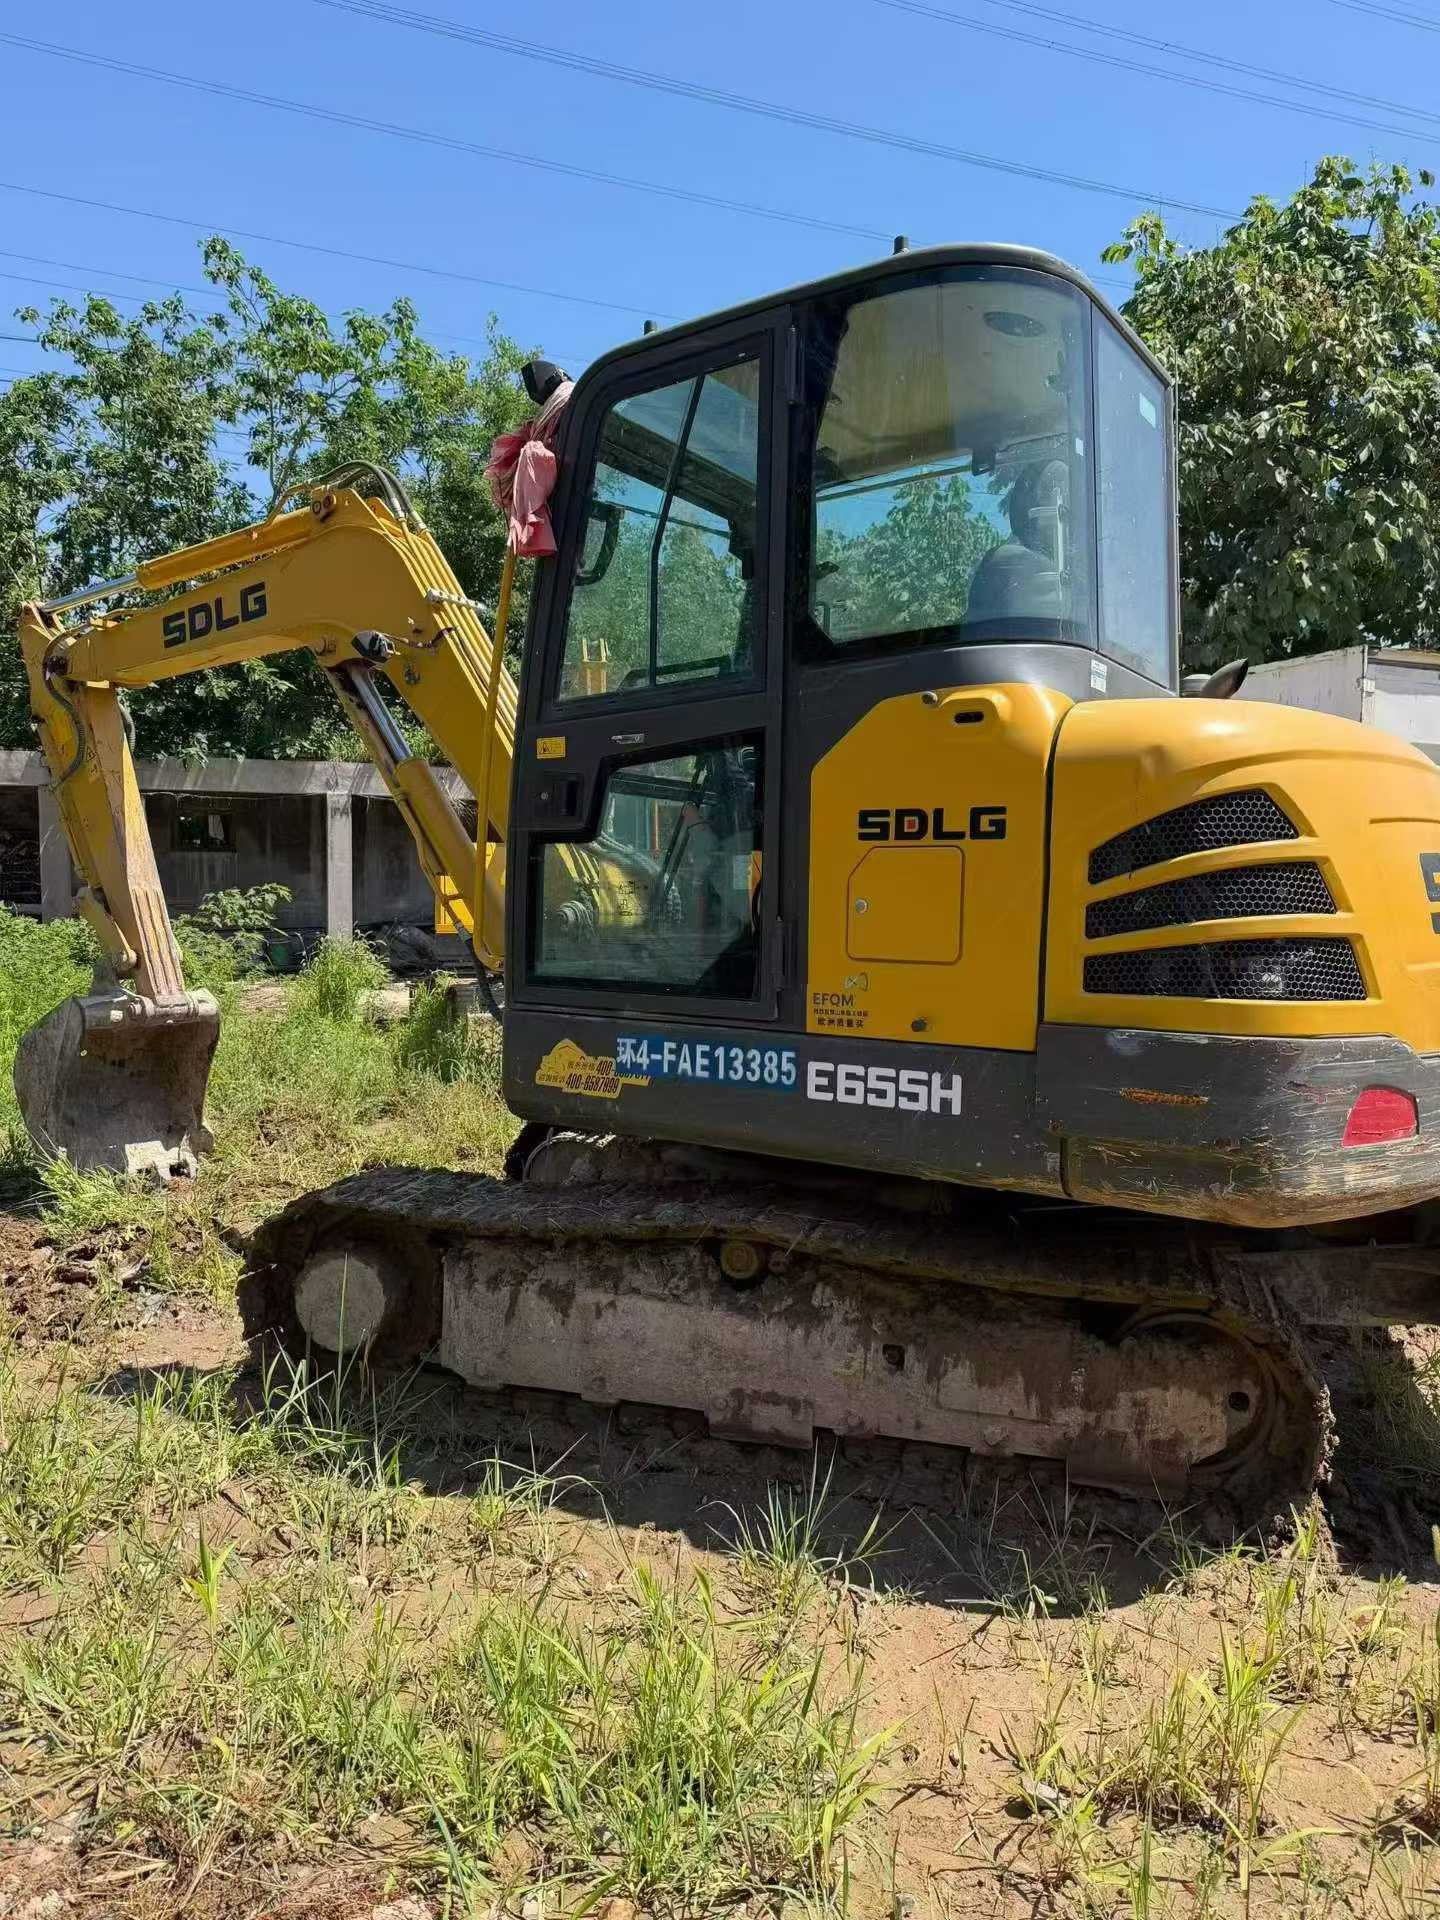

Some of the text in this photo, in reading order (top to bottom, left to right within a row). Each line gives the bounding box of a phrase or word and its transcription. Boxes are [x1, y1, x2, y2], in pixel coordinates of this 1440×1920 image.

[163, 582, 267, 649] SDLG
[857, 806, 1007, 841] SDLG
[813, 992, 854, 1007] EFQM
[616, 1037, 796, 1085] 环4-FAE13385
[807, 1061, 962, 1115] E655H
